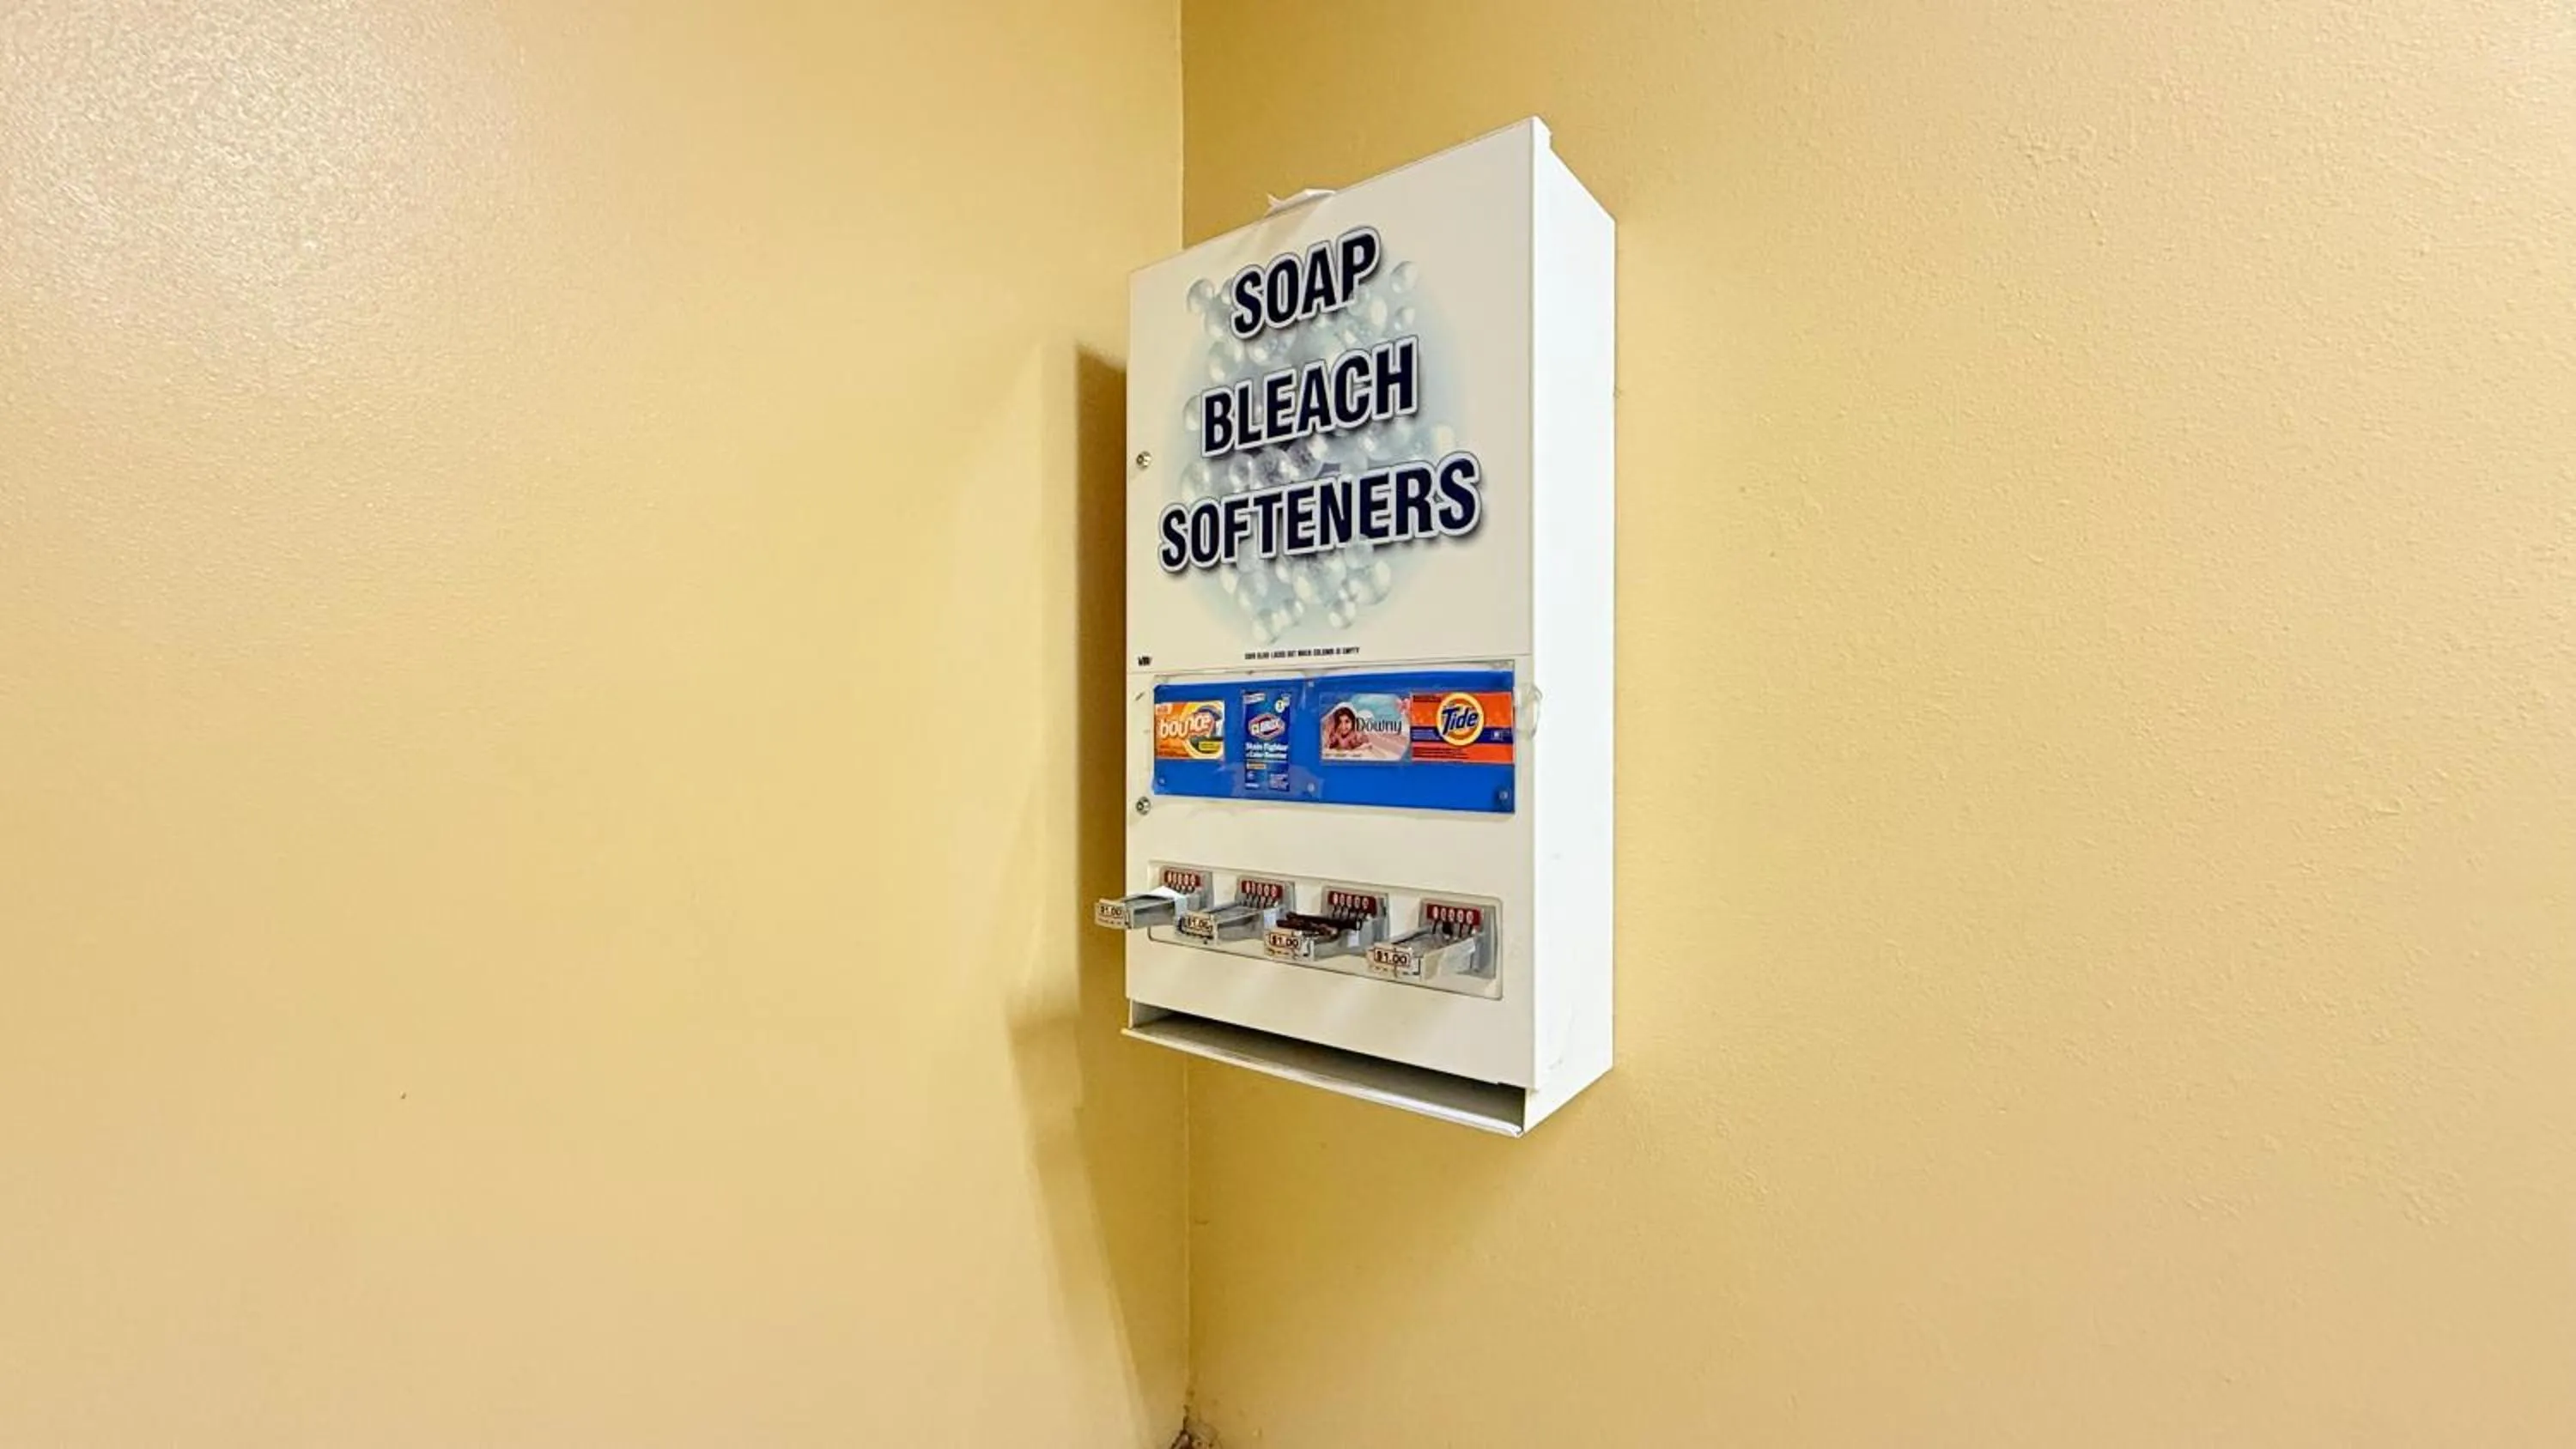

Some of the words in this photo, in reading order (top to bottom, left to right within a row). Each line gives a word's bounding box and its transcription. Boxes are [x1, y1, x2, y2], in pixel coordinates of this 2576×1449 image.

[1231, 227, 1380, 338] SOAP
[1202, 336, 1418, 456] BLEACH
[1159, 452, 1480, 571] SOFTENERS
[1356, 717, 1402, 736] Downy
[1442, 706, 1479, 736] Tide
[1271, 934, 1299, 948] $1.00
[1376, 949, 1408, 965] $1.00
